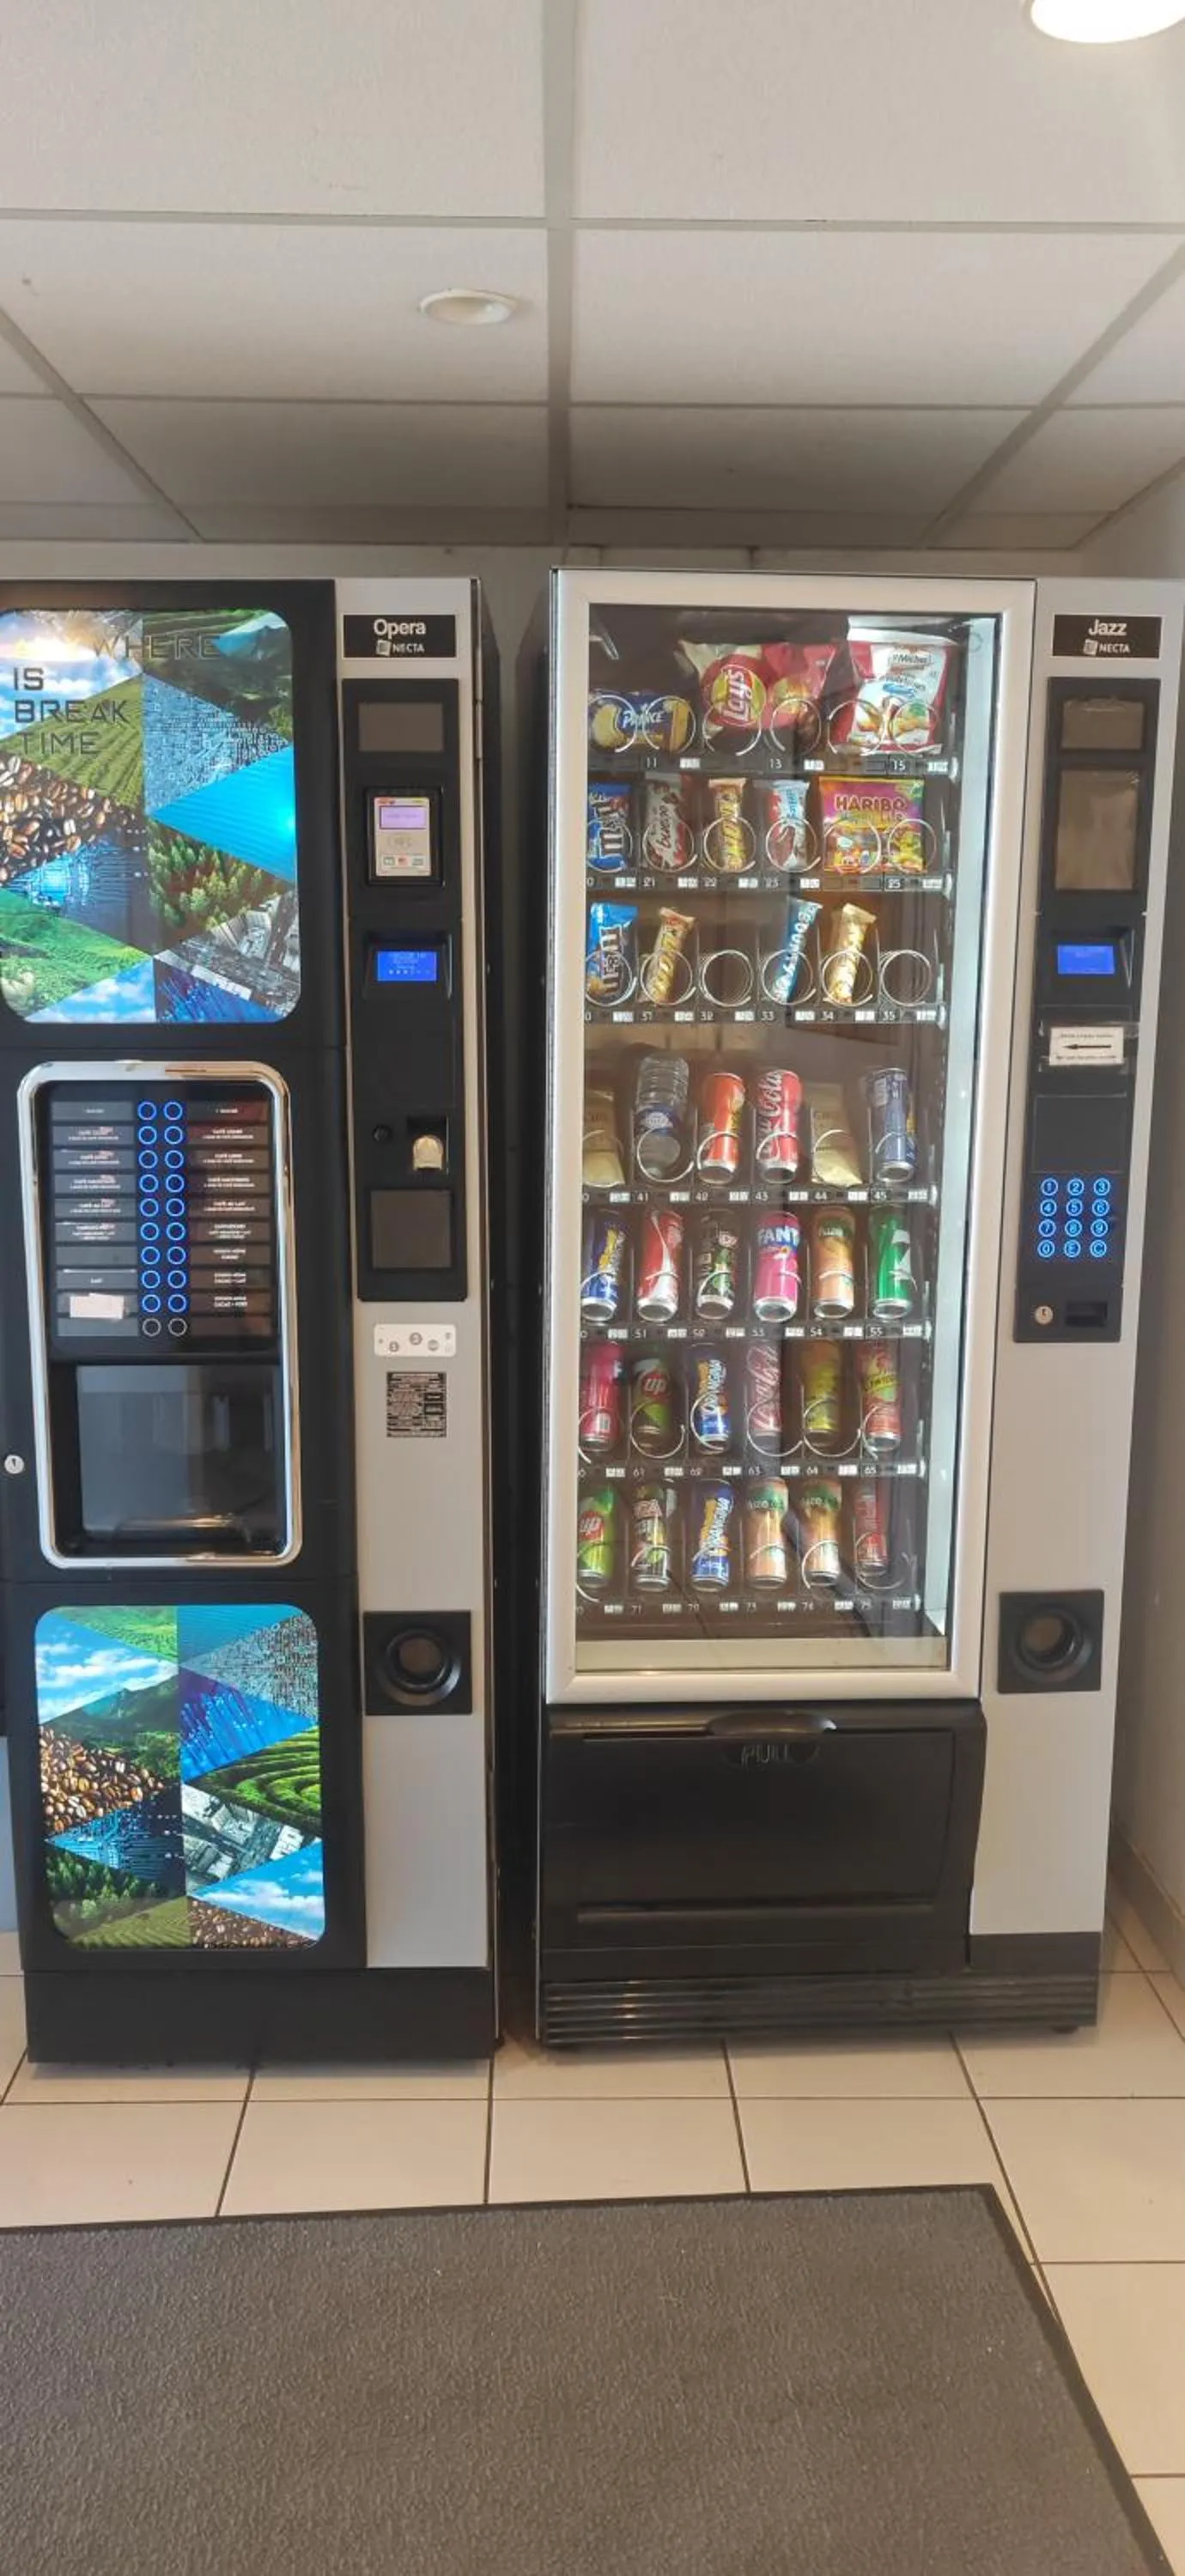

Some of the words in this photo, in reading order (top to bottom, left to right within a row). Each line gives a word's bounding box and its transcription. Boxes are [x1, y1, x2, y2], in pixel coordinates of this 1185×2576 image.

[374, 618, 427, 640] Opera
[1088, 618, 1127, 636] Jazz
[392, 642, 426, 653] NECTA
[1099, 642, 1131, 653] NECTA
[13, 666, 45, 691] IS
[15, 699, 130, 723] BREAK
[16, 731, 100, 756] TIME
[835, 795, 906, 811] HARIBO
[757, 1225, 800, 1246] FANT
